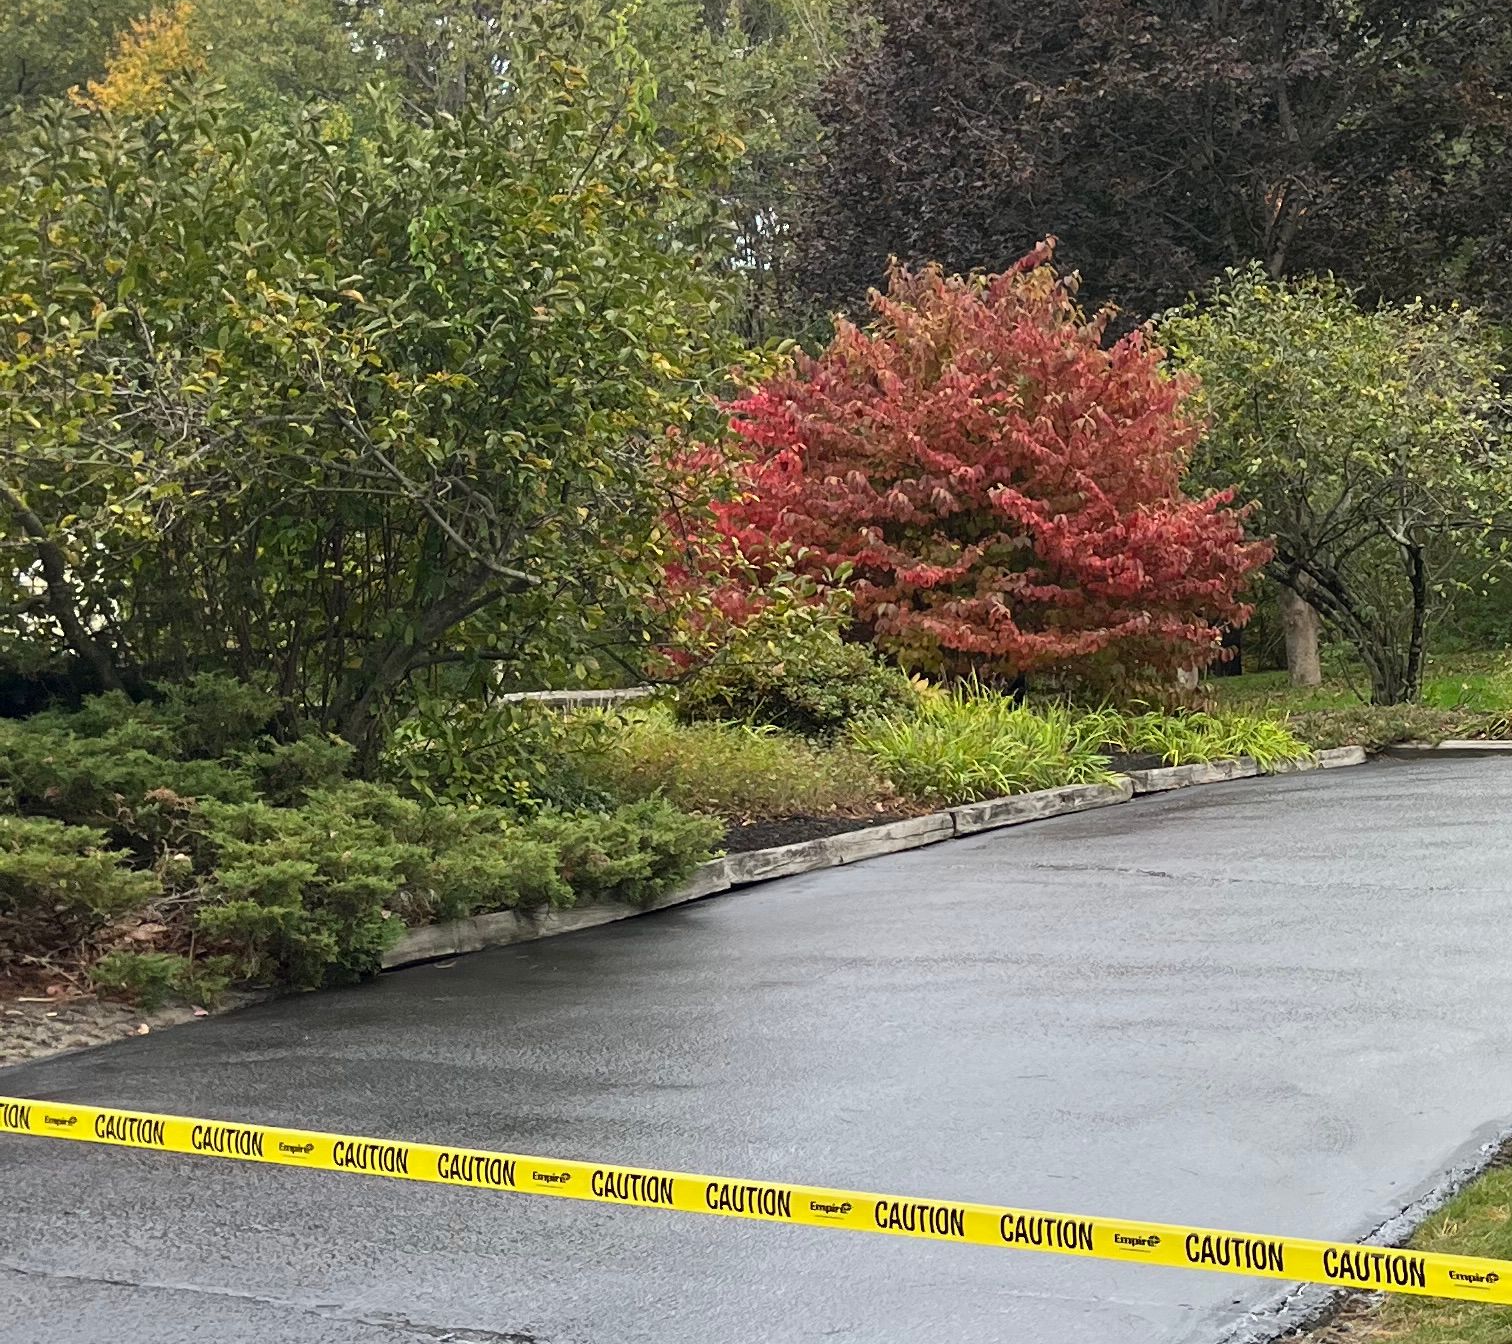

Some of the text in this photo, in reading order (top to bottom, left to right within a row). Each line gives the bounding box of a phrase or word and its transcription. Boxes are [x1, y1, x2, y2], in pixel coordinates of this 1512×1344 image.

[94, 1114, 165, 1146] CAUTION
[191, 1125, 264, 1157] CAUTION
[333, 1140, 409, 1175] CAUTION
[437, 1152, 517, 1187] CAUTION
[591, 1169, 674, 1205] CAUTION
[705, 1182, 792, 1218] CAUTION
[874, 1200, 965, 1237] CAUTION
[1000, 1213, 1094, 1251] CAUTION
[1185, 1233, 1284, 1272] CAUTION
[1323, 1248, 1426, 1288] CAUTION
